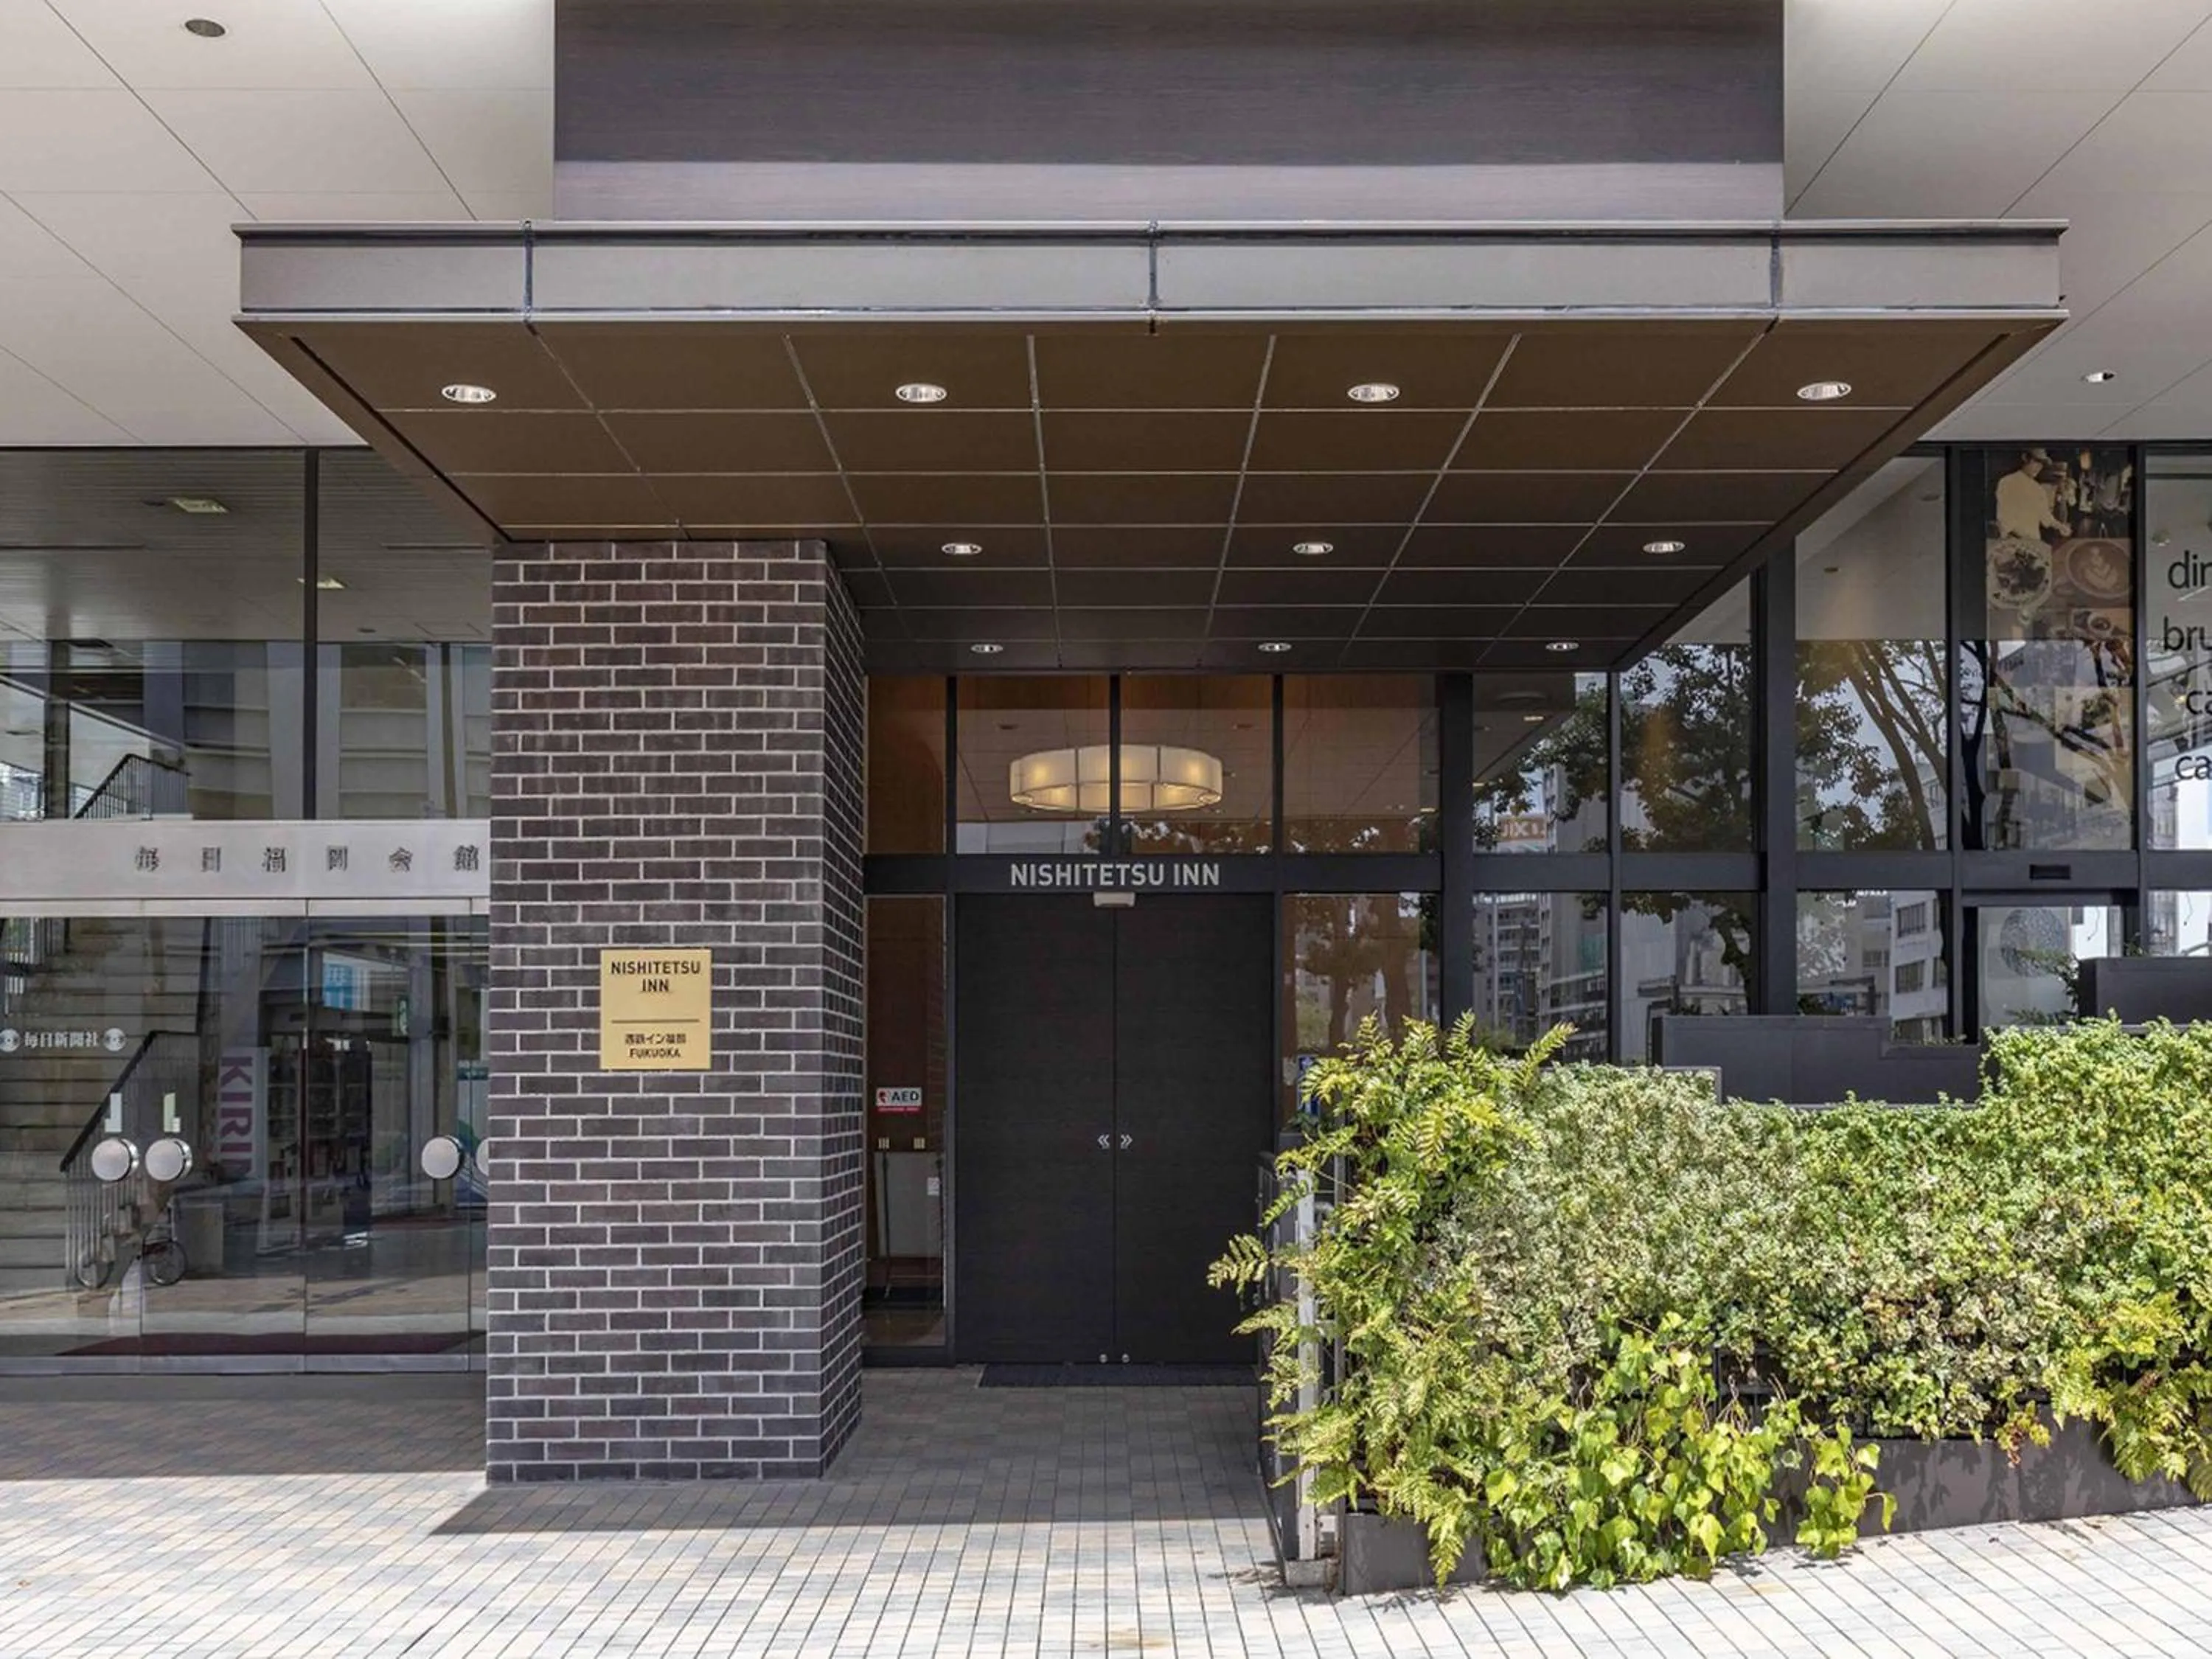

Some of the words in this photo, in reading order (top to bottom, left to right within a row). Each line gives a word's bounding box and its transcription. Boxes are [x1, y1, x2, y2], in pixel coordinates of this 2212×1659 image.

[1010, 863, 1165, 886] NISHITETSU
[1173, 863, 1220, 886] INN
[611, 961, 700, 975] NISHITETSU
[642, 978, 669, 992] INN
[629, 1048, 681, 1059] FUKUOKA
[891, 1091, 919, 1102] AED
